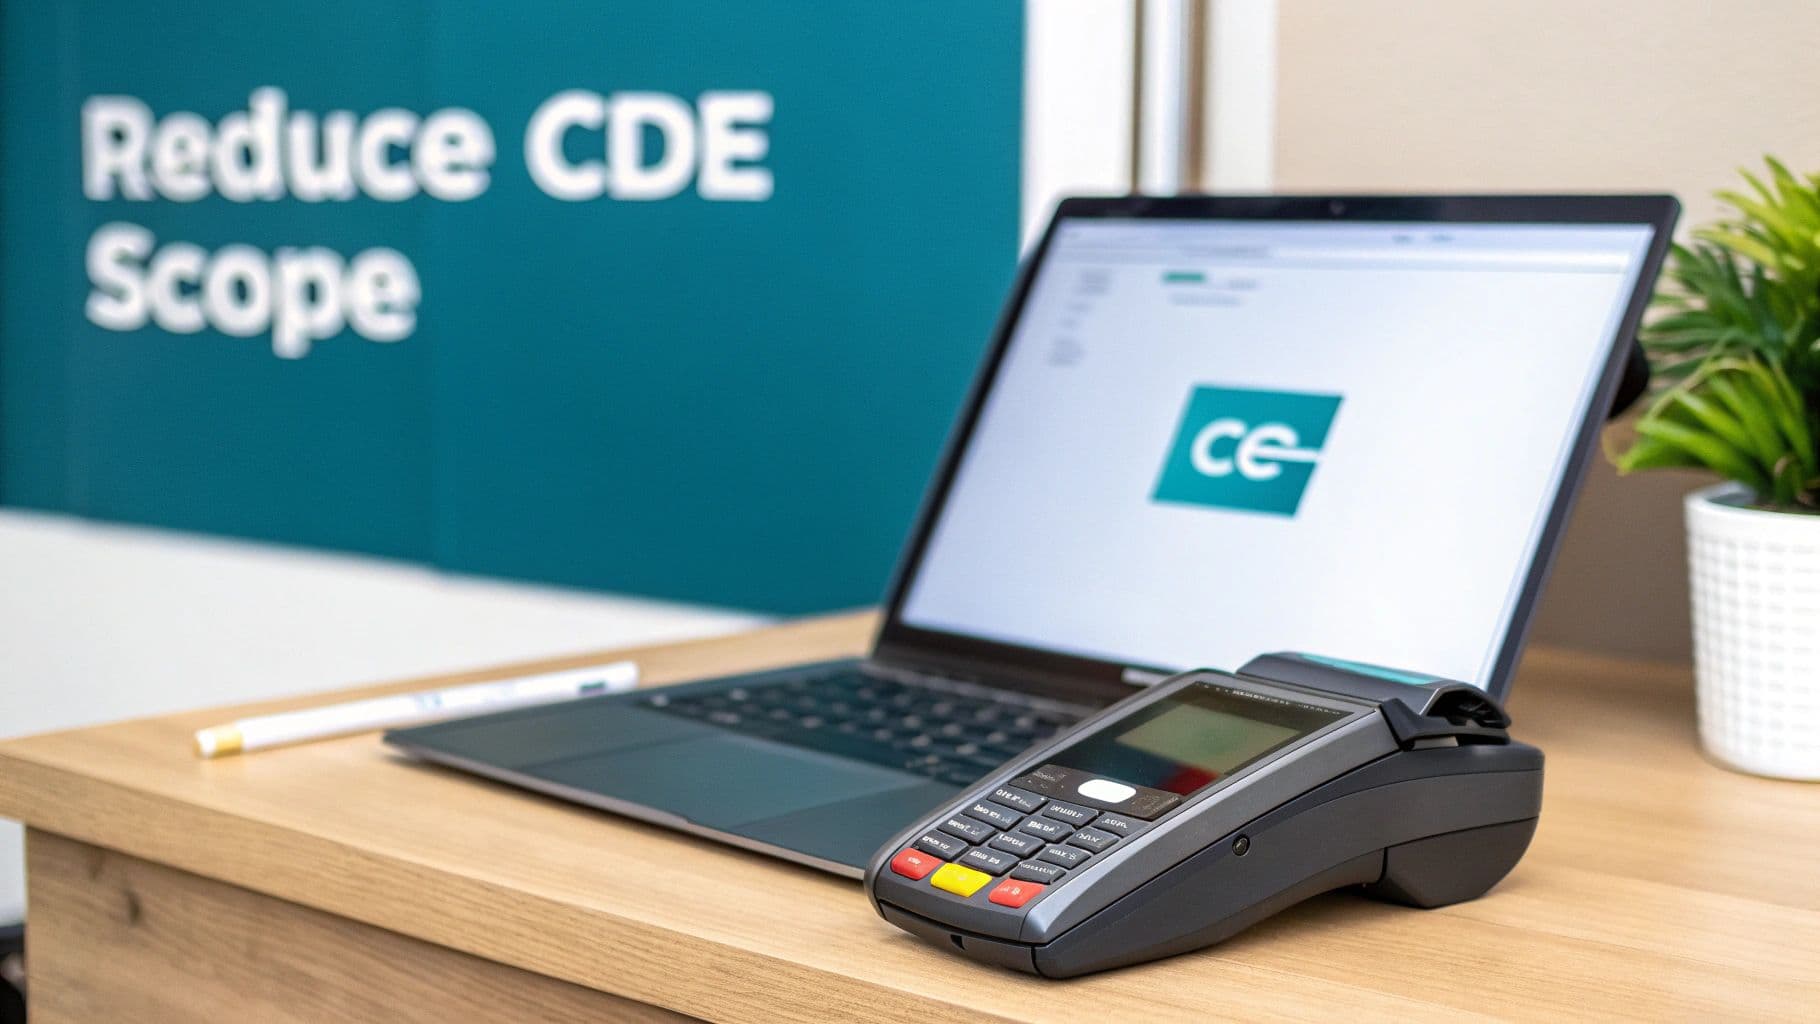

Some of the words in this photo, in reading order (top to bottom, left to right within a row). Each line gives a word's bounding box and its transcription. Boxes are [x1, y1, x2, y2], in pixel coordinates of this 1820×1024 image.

[82, 87, 495, 202] Reduce
[524, 89, 774, 202] CDE
[85, 222, 421, 358] Scope
